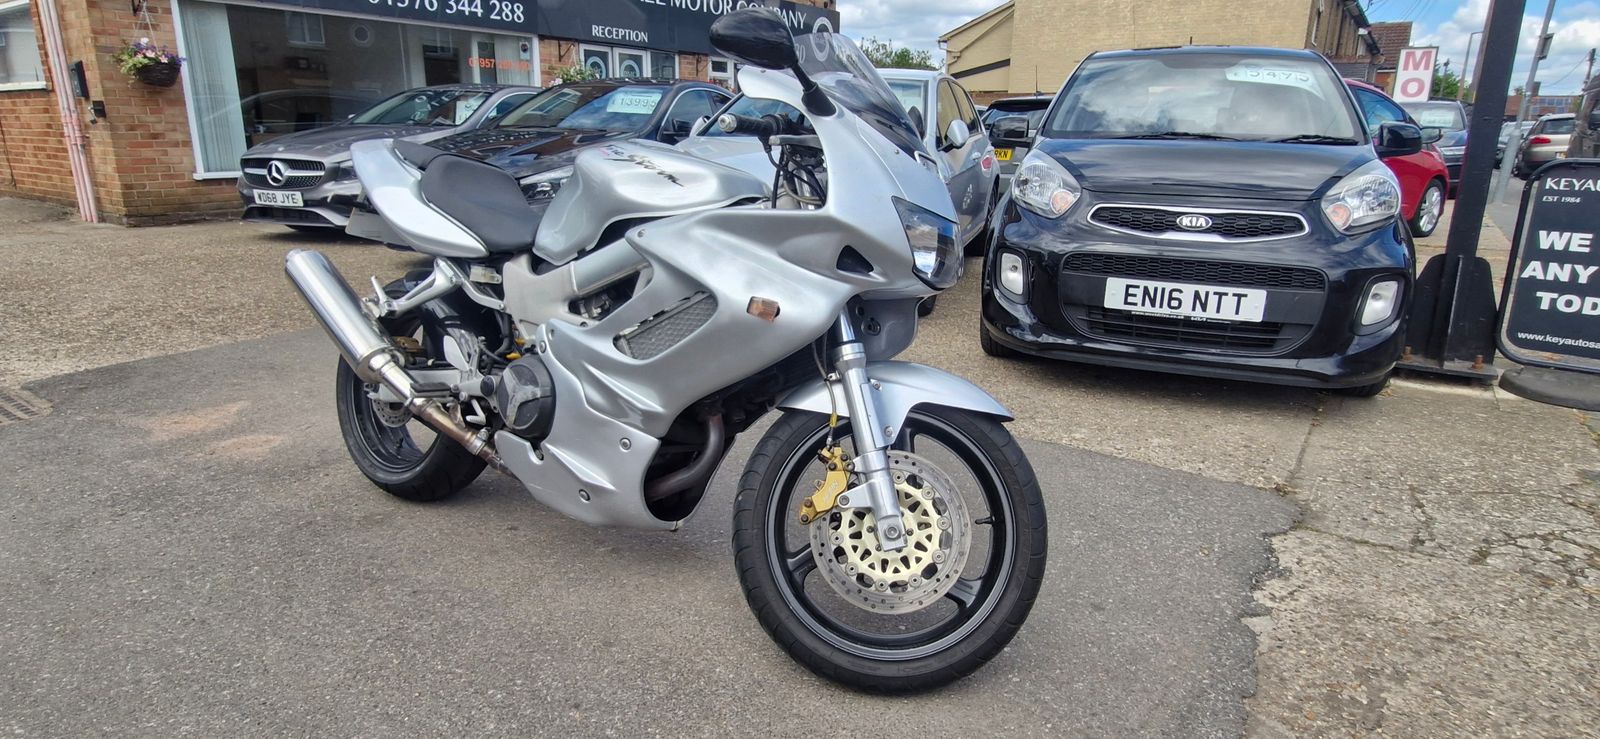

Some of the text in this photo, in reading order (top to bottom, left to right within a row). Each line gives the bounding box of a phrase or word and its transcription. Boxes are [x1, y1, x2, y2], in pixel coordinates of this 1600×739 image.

[489, 0, 525, 23] 288
[736, 1, 807, 29] CANY
[591, 24, 649, 43] RECEPTION
[1545, 177, 1600, 191] KEYA
[280, 193, 299, 204] JYE
[1182, 216, 1207, 227] KIA
[1538, 230, 1593, 253] WE
[1520, 260, 1600, 284] ANY
[1123, 284, 1248, 315] EN16 NTT
[1535, 291, 1600, 316] TOD
